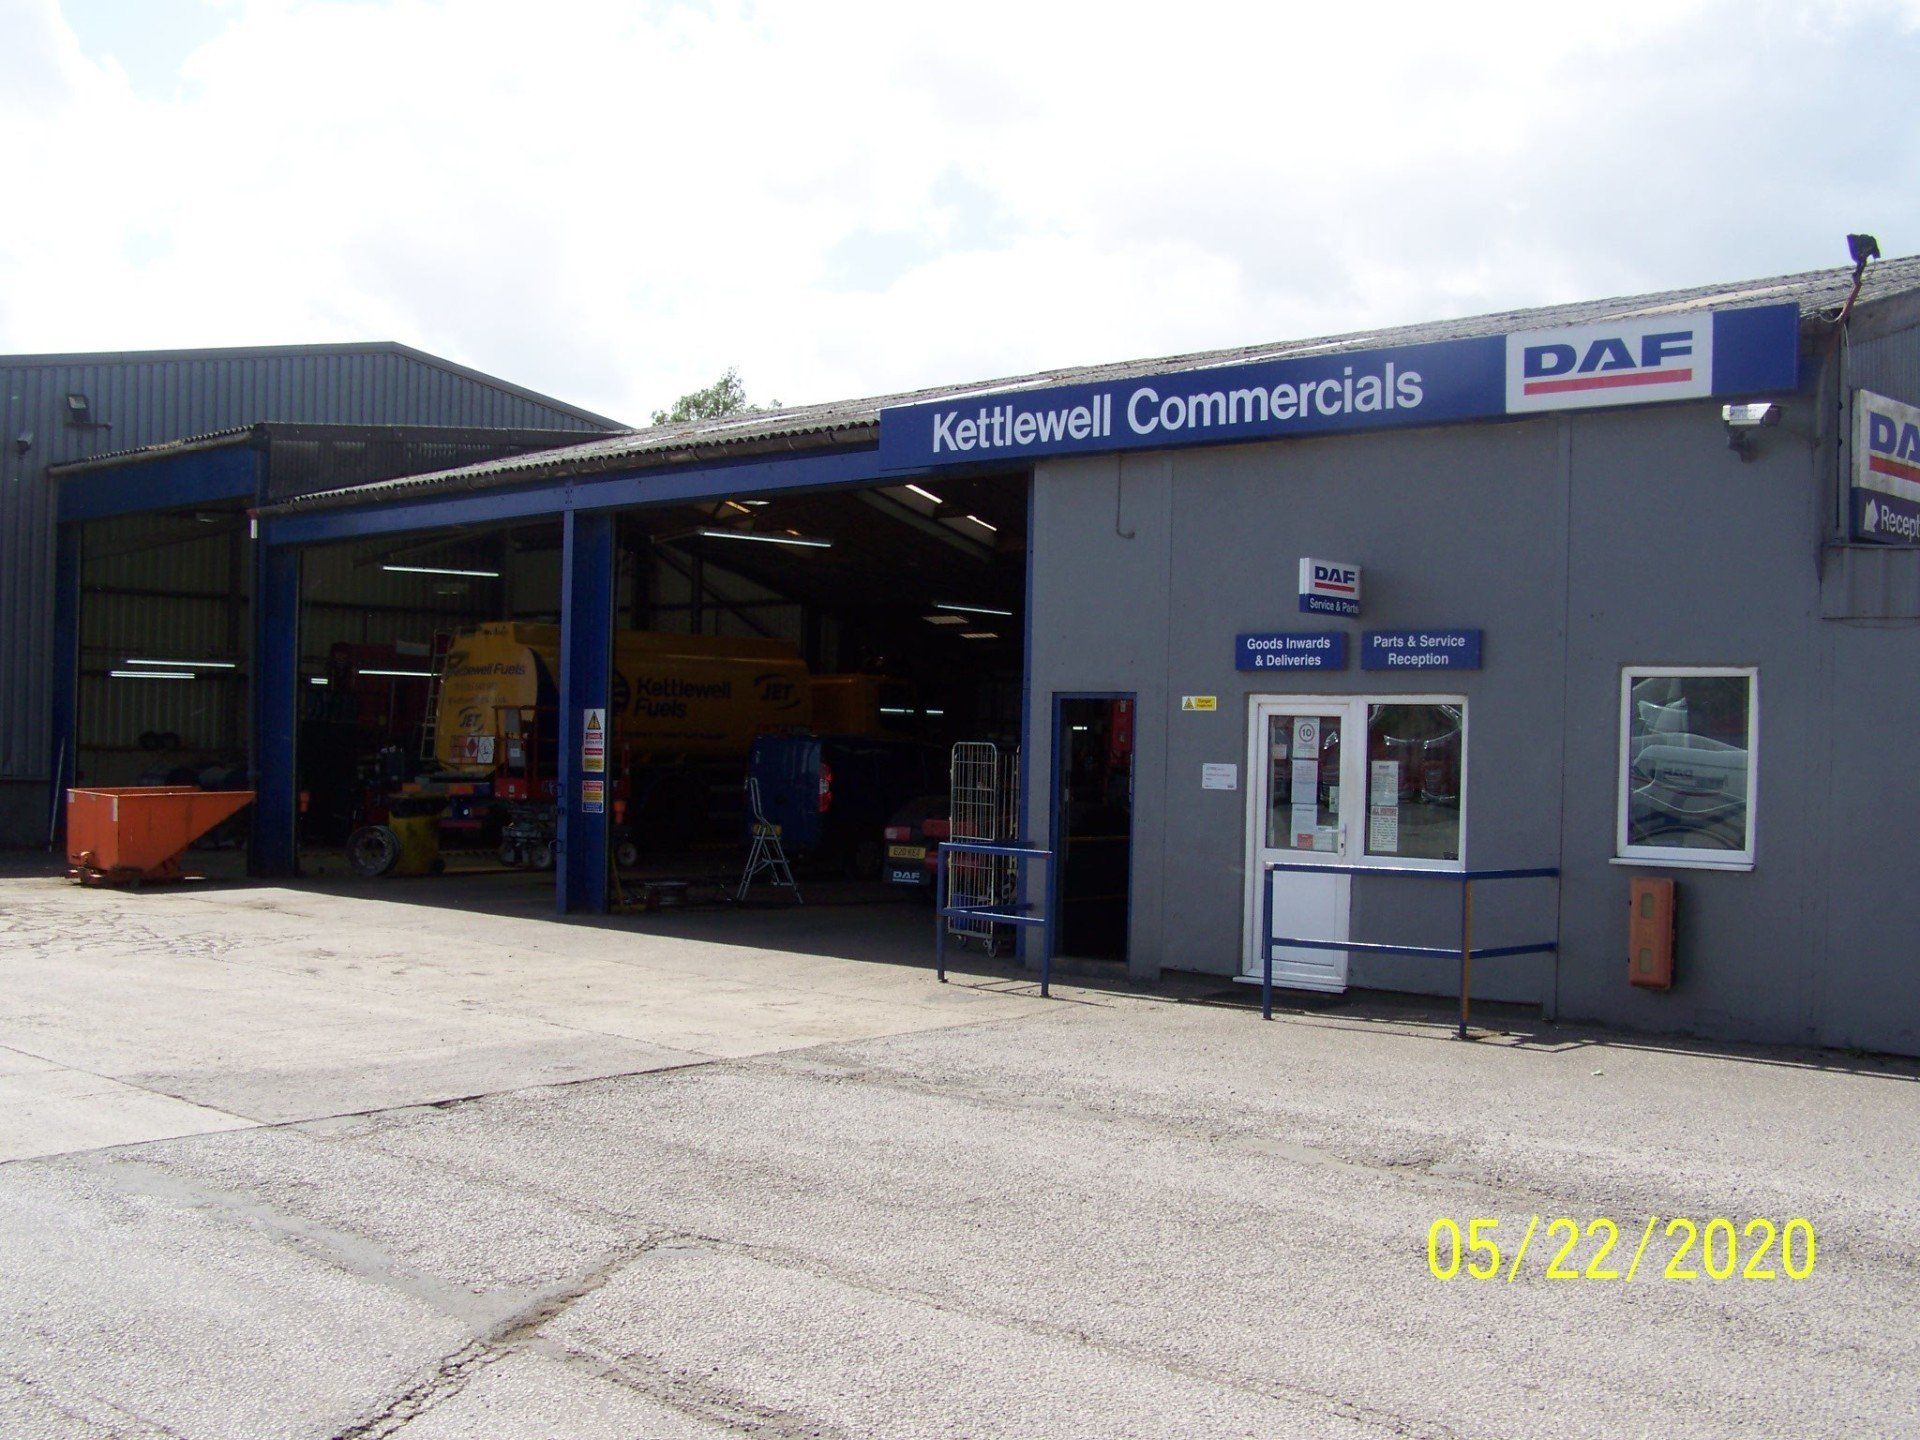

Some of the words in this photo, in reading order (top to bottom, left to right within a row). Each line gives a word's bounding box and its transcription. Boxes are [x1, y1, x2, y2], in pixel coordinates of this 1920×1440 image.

[1523, 330, 1694, 379] DAF
[932, 393, 1110, 454] Kettlewell
[1127, 361, 1424, 435] Commercials
[1314, 565, 1356, 584] DAF
[1310, 597, 1335, 611] Service
[1335, 601, 1341, 612] &
[1246, 637, 1283, 650] Goods
[1286, 636, 1332, 649] Inwards
[1373, 635, 1404, 648] Parts
[1406, 635, 1416, 647] &
[1419, 634, 1466, 647] Service
[1255, 655, 1264, 666] &
[1266, 654, 1322, 666] Deliveries
[1388, 652, 1450, 667] Reception
[492, 663, 526, 675] Fuels
[637, 677, 732, 699] Kettlewell
[761, 683, 796, 700] JET
[634, 697, 688, 718] Fuels
[1302, 728, 1312, 737] 10
[892, 870, 921, 880] DAF
